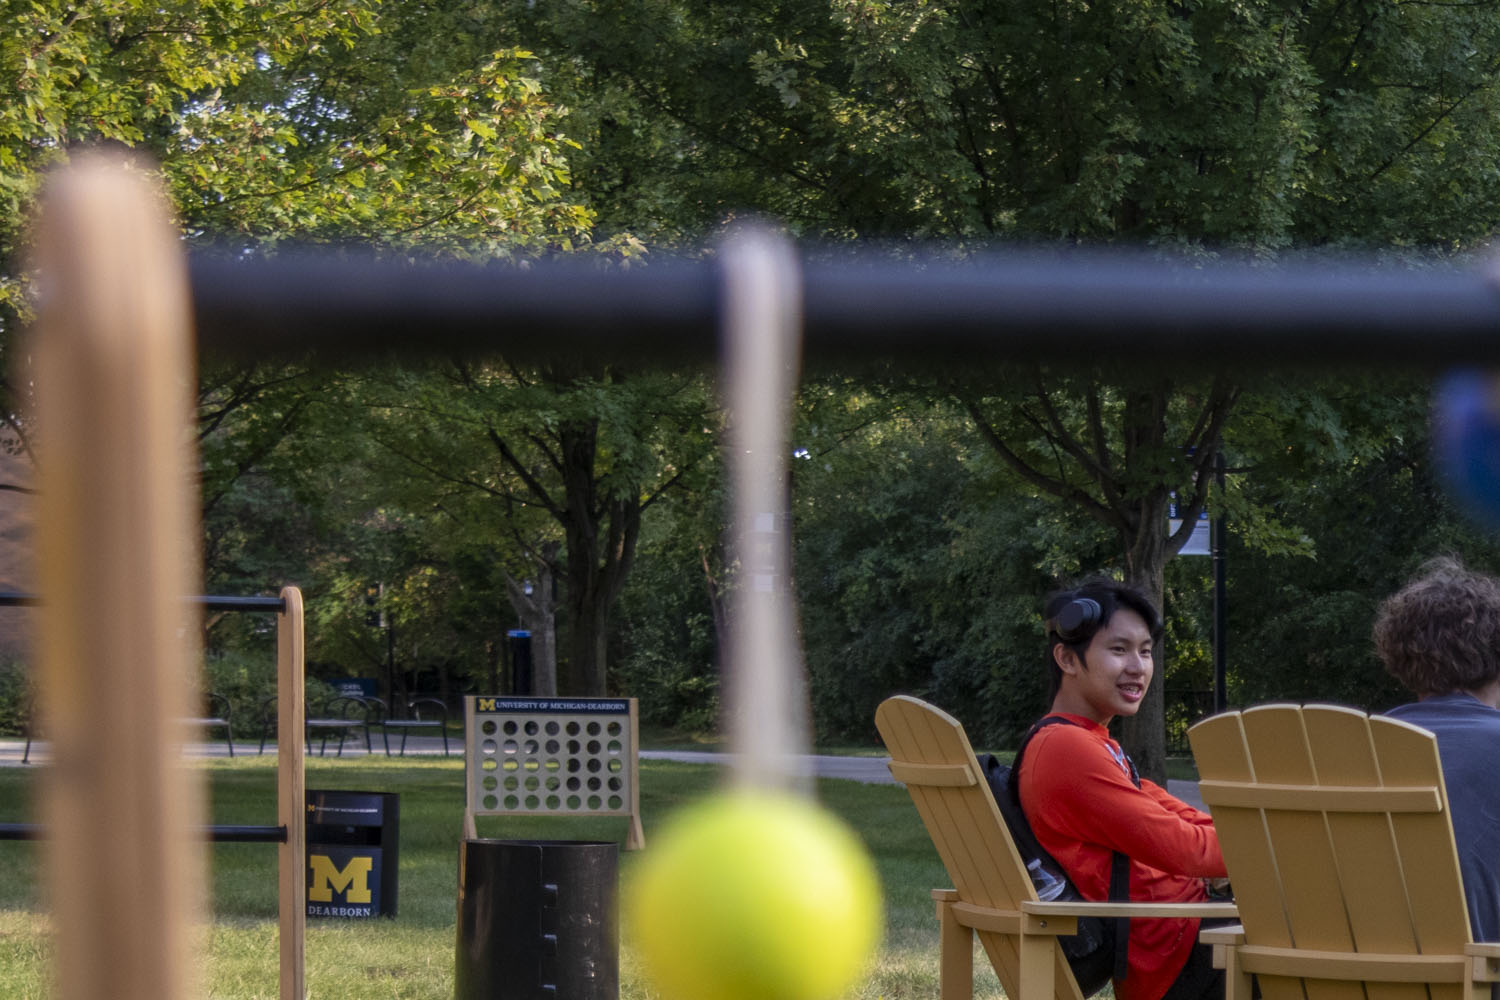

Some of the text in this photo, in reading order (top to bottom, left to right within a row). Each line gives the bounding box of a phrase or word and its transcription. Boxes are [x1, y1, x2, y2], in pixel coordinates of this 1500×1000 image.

[496, 701, 537, 709] UNIVERSITY
[550, 702, 626, 710] MICHIGAN-DEARBORN
[309, 855, 373, 903] M
[308, 906, 371, 917] DEARBORN
